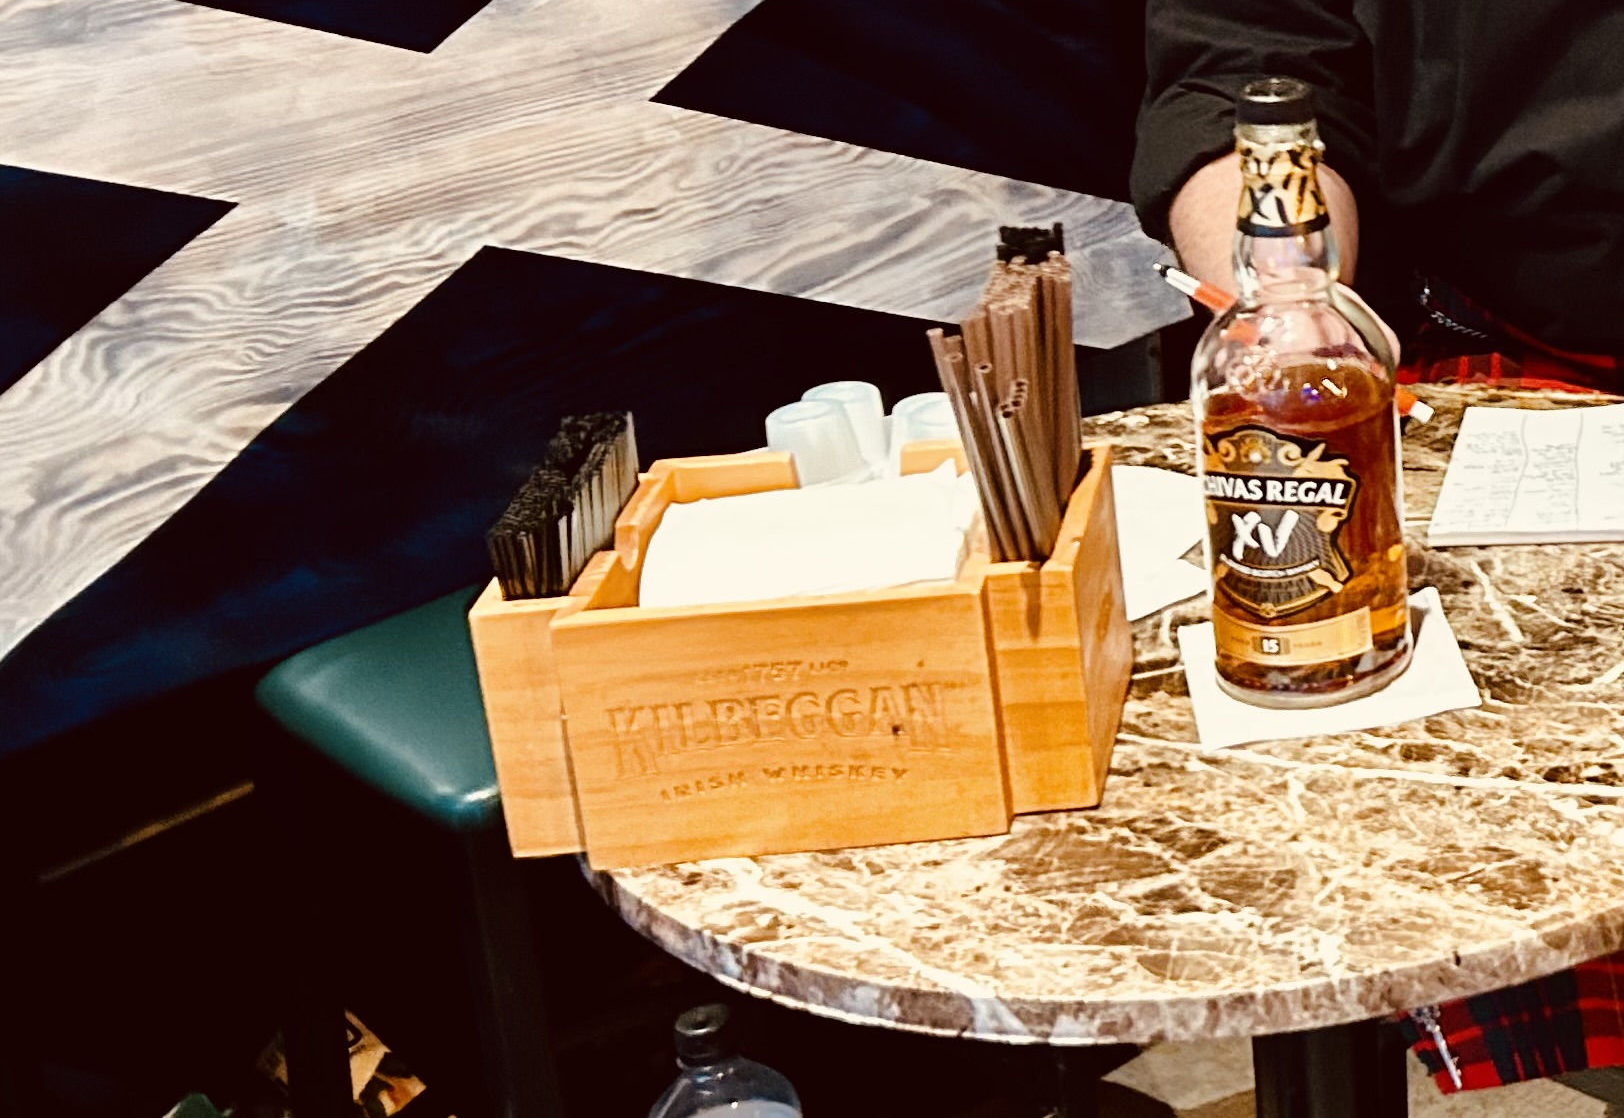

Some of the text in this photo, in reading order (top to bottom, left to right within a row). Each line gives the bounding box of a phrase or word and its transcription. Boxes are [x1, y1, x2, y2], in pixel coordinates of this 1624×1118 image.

[1265, 479, 1347, 506] REGAL
[1231, 509, 1300, 562] XV
[1261, 638, 1280, 654] 15
[605, 681, 962, 778] KILBEGGAN
[660, 763, 910, 801] IRISH WHISKEY
